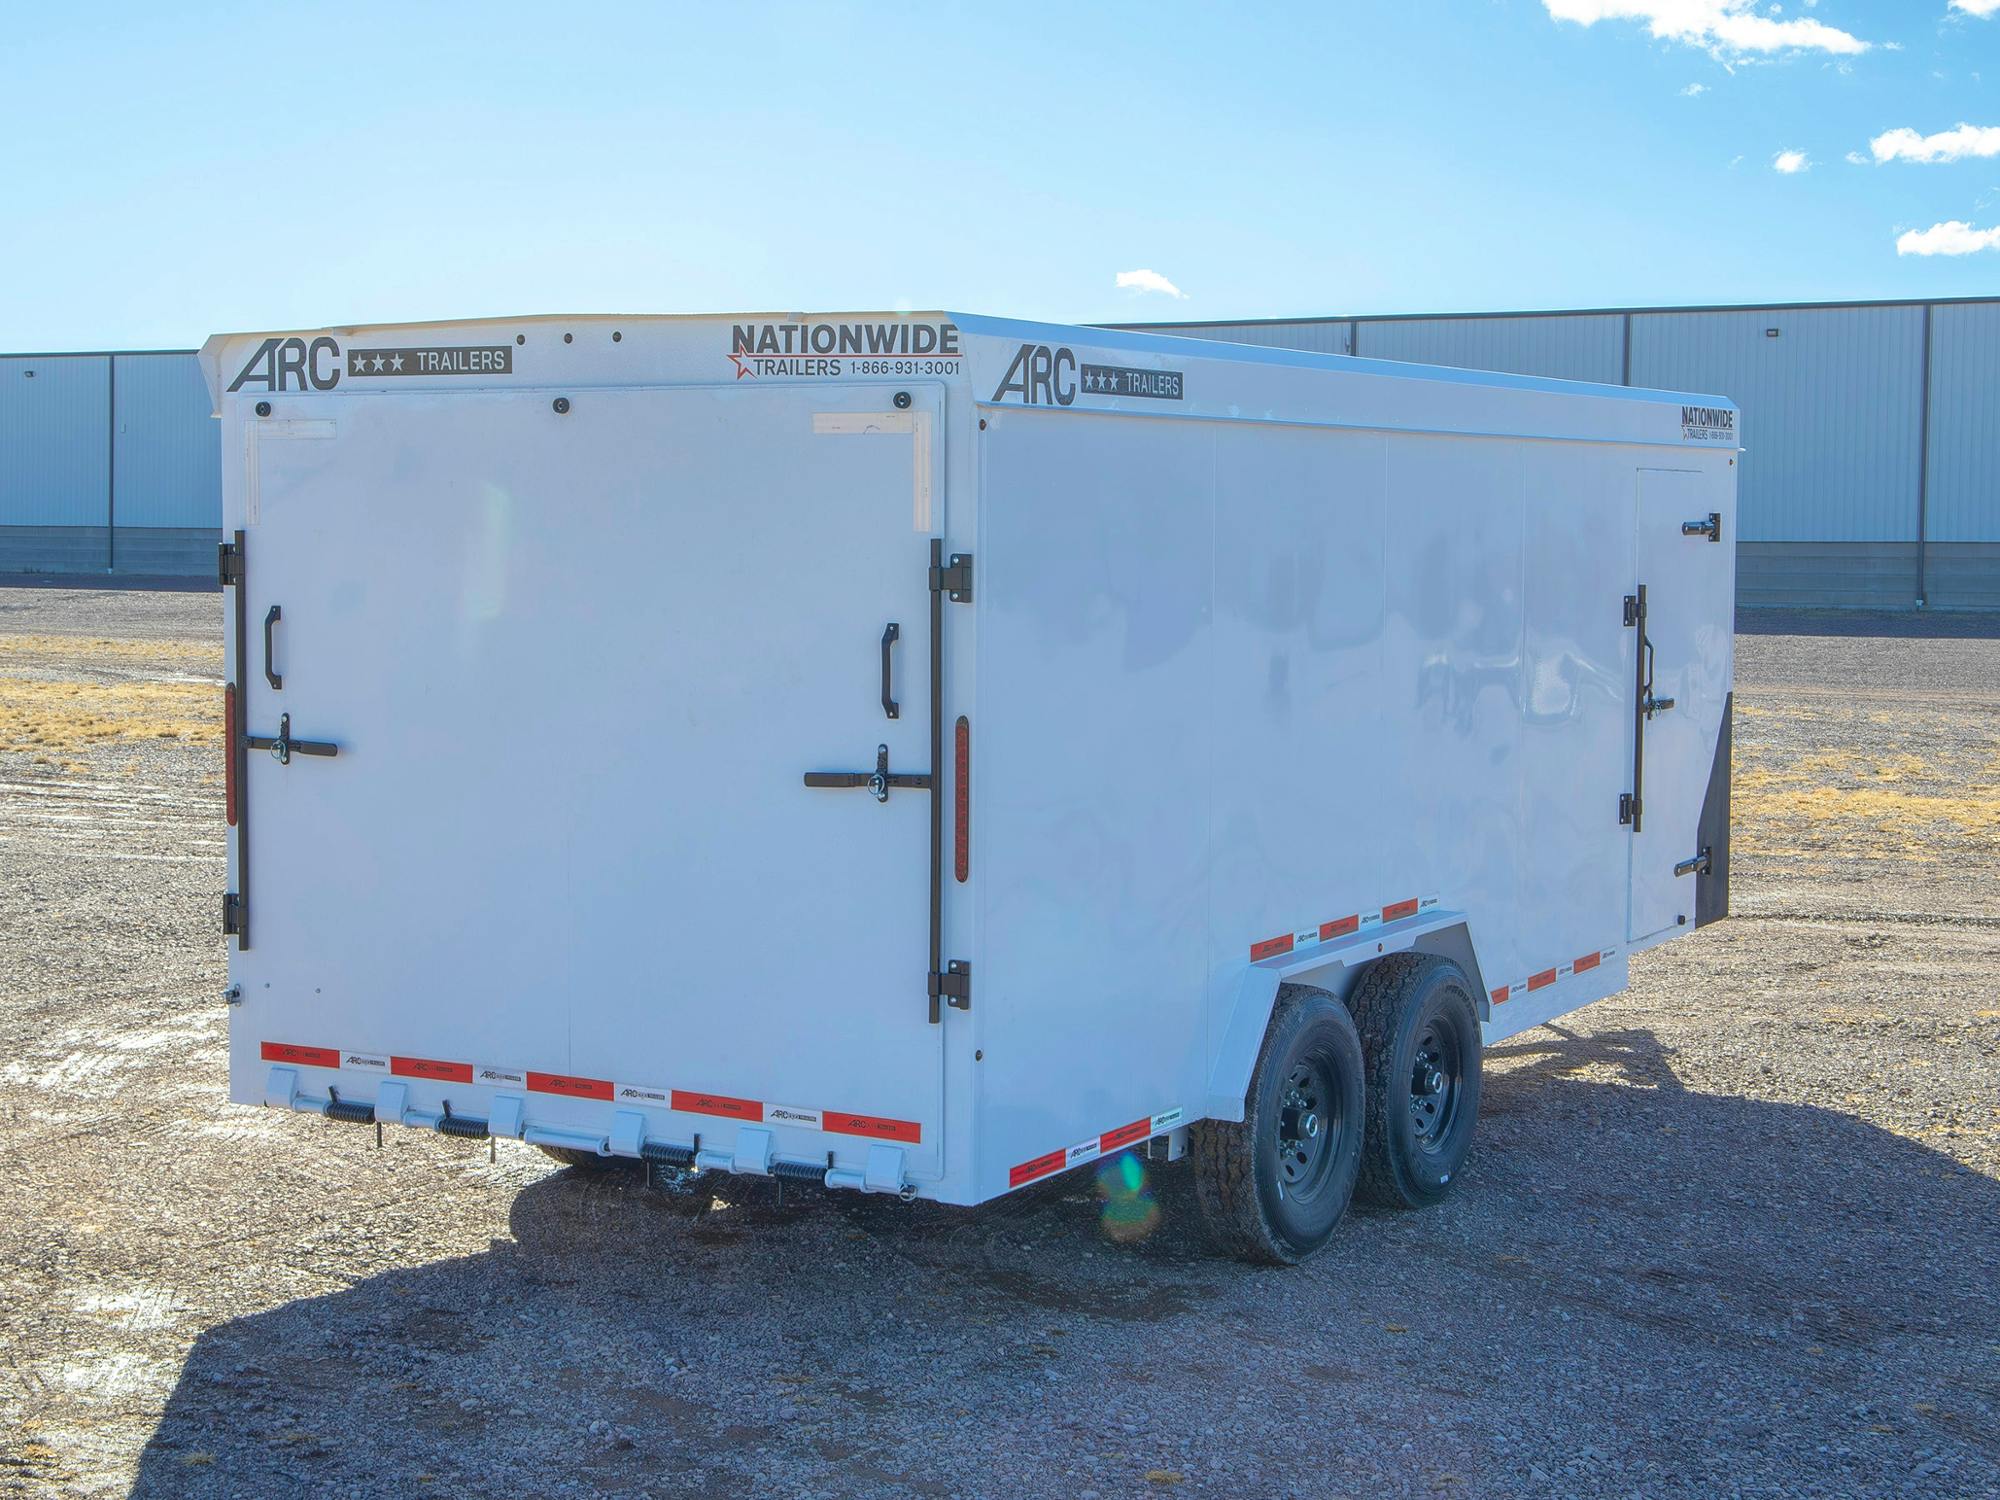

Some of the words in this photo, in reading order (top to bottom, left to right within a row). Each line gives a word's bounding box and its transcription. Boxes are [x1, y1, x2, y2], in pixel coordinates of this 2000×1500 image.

[732, 323, 959, 355] NATIONWIDE
[226, 336, 341, 392] ARC
[416, 350, 506, 372] TRAILERS
[753, 358, 842, 377] TRAILERS
[850, 361, 960, 376] 1-866-931-3001
[991, 343, 1077, 407] ARC
[1126, 371, 1181, 397] TRAILERS
[1682, 406, 1733, 428] NATIONWIDE
[770, 1109, 788, 1120] ARC
